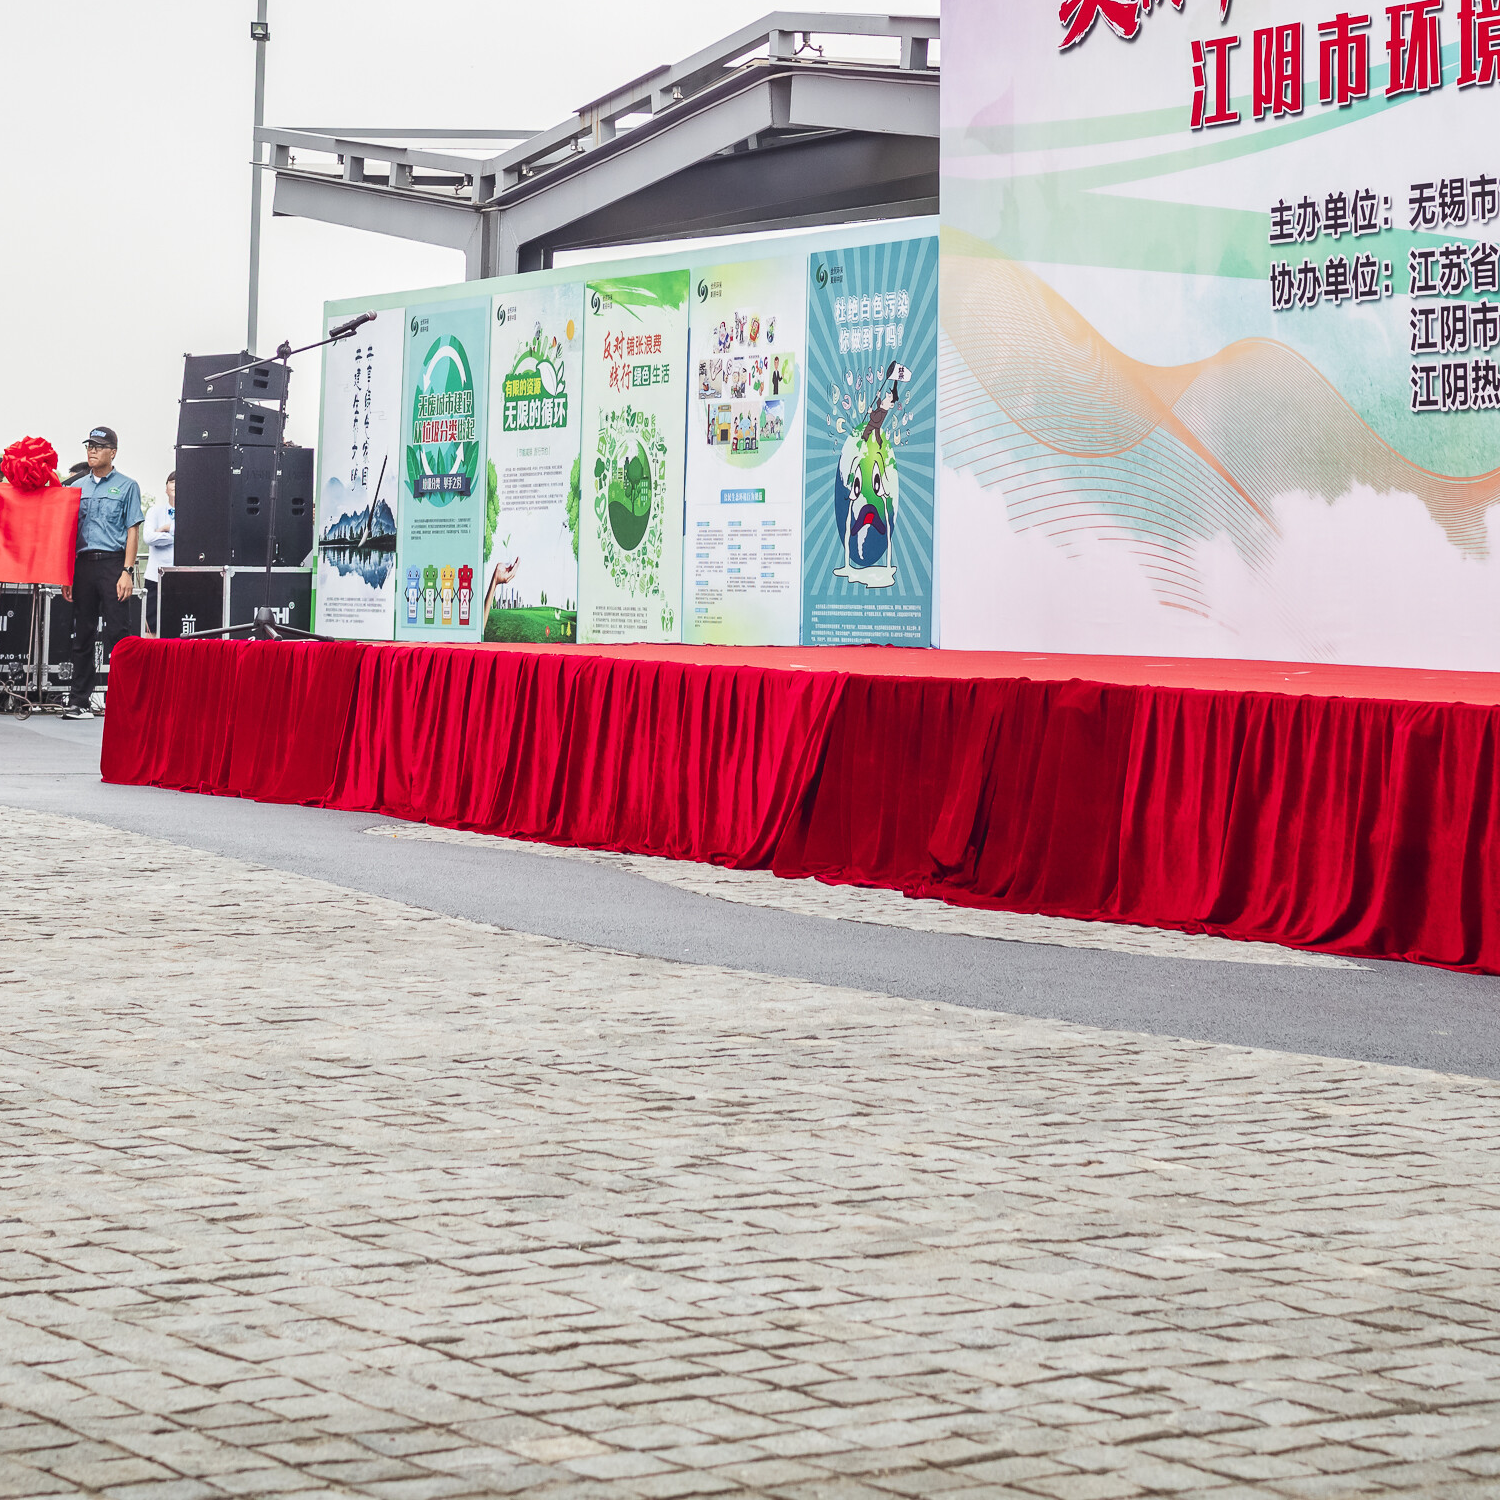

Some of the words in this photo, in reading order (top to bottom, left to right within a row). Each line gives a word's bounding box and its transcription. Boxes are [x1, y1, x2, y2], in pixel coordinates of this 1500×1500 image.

[835, 289, 909, 325] 杜绝白色污染
[505, 377, 541, 397] 有限的资源
[418, 390, 473, 418] 无废城市建设
[505, 397, 567, 429] 无限的循环
